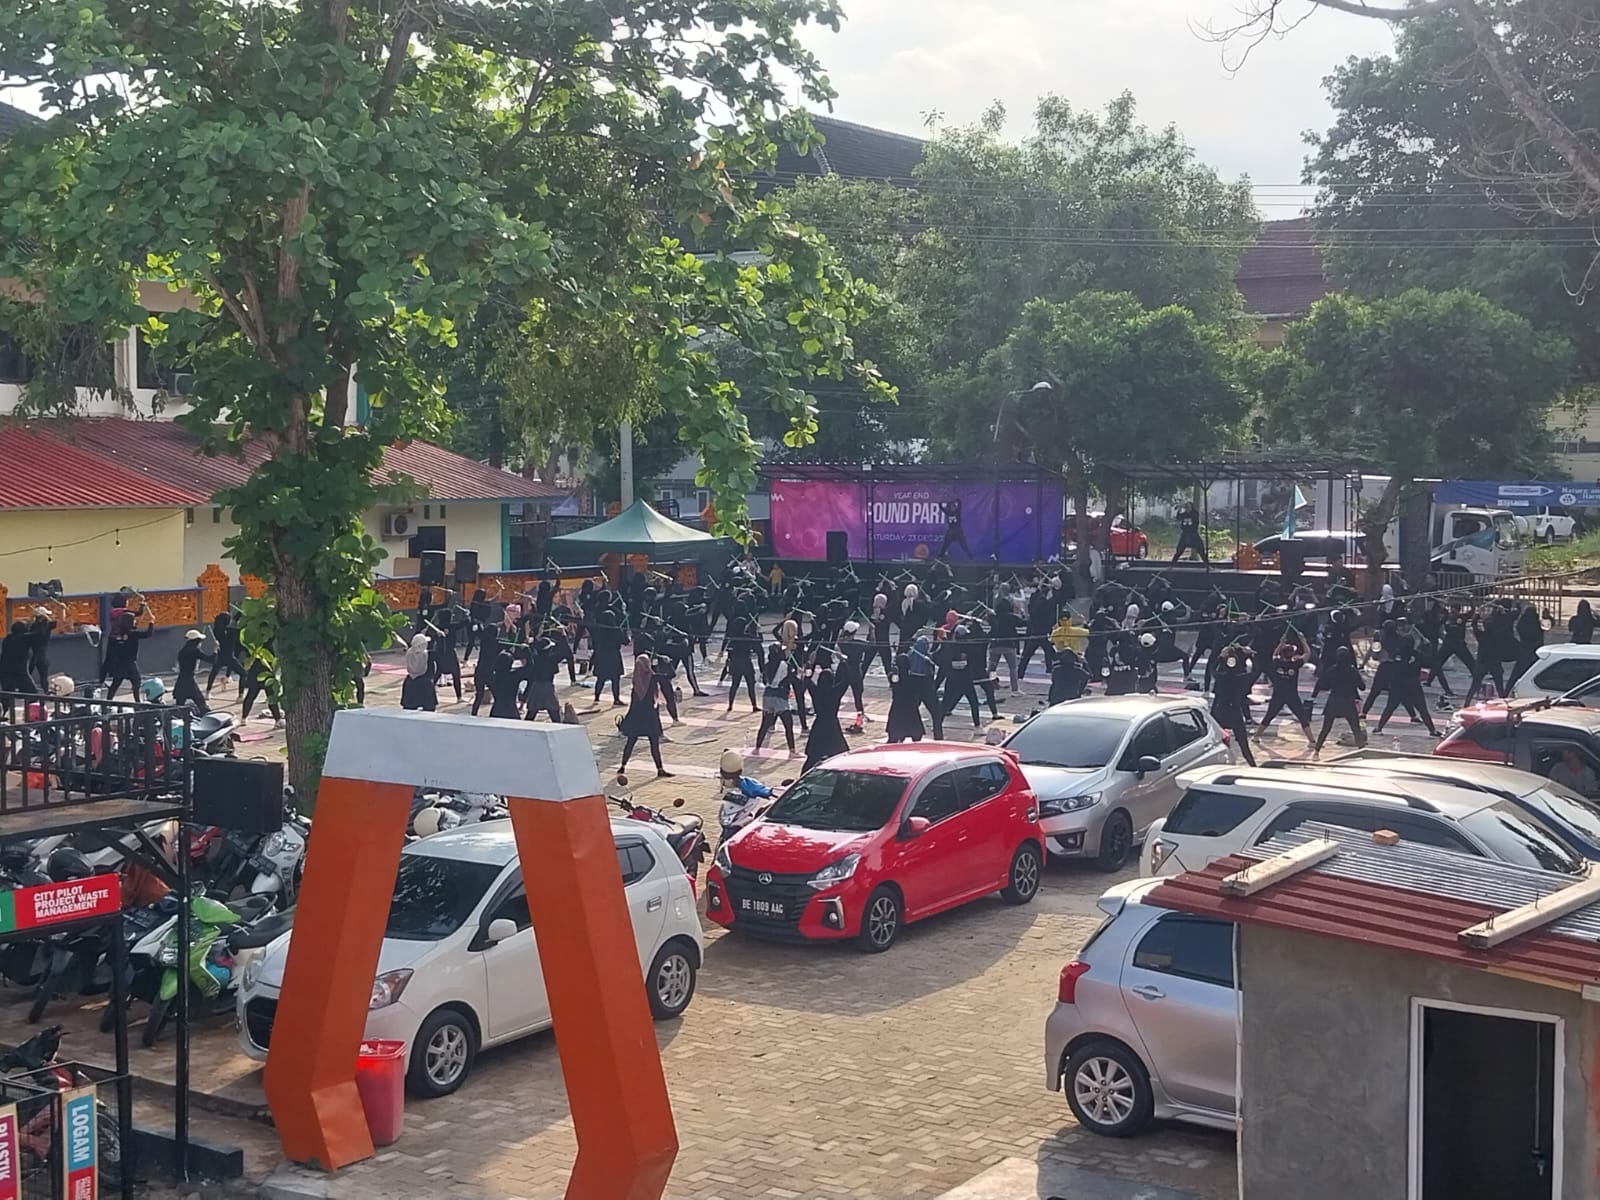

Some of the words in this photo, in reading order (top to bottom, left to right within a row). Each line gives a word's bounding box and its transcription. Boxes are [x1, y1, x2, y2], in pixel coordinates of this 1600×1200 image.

[913, 492, 929, 500] END
[33, 890, 55, 903] CITY
[56, 885, 83, 898] PILOT
[34, 895, 76, 911] PROJECT
[77, 889, 109, 903] WASTE
[35, 899, 97, 918] MANAGEMENT
[72, 1104, 90, 1163] LOGAM
